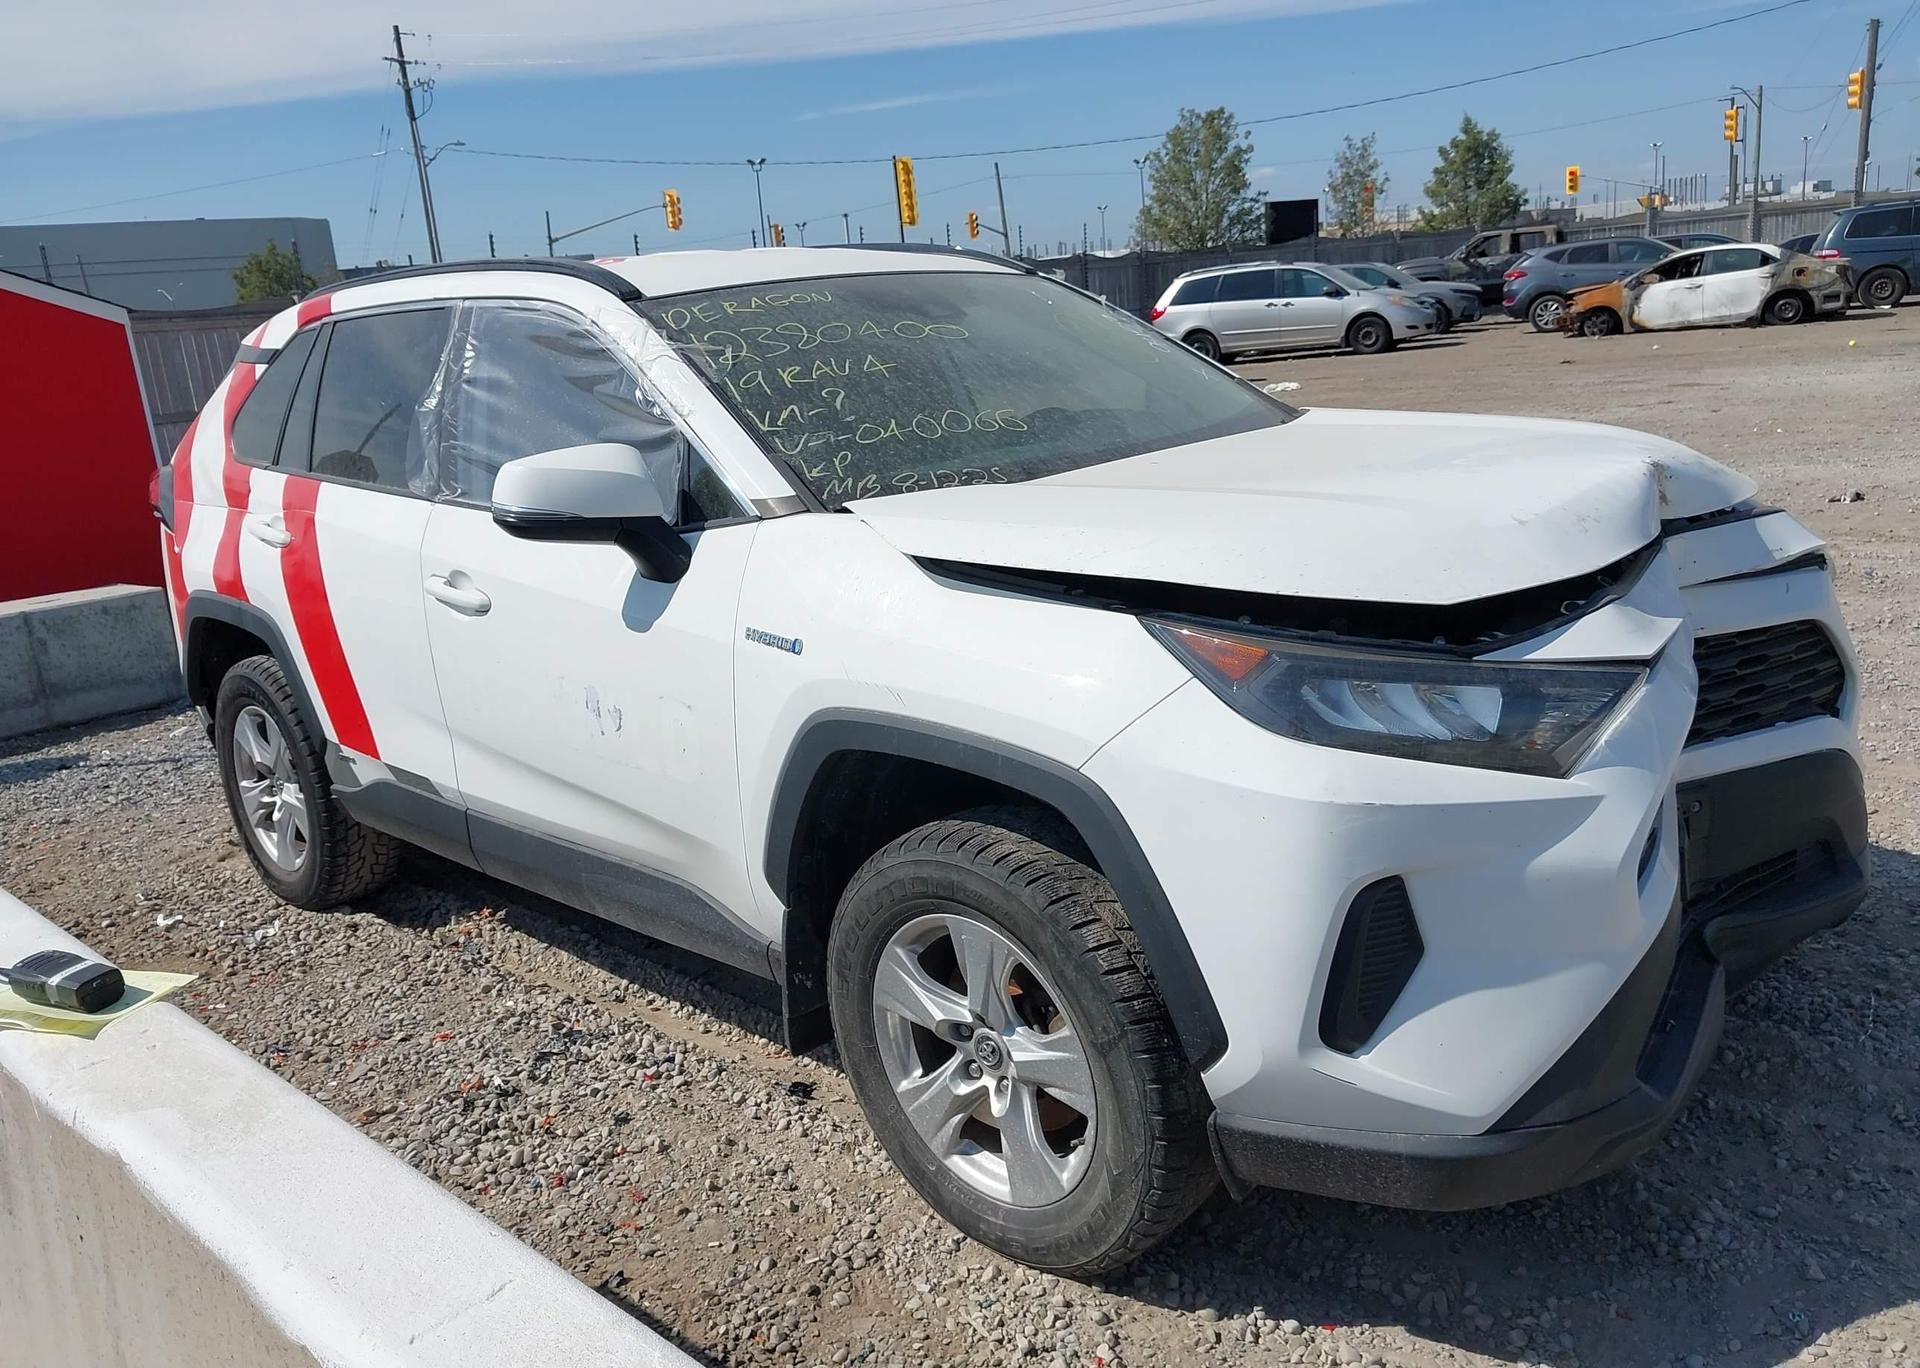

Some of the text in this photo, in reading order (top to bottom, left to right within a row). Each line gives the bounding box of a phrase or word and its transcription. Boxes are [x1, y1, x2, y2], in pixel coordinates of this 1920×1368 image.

[689, 320, 969, 372] 12380400
[723, 370, 773, 403] 19
[891, 466, 1009, 494] 8-12-25
[744, 626, 797, 653] HYBRID
